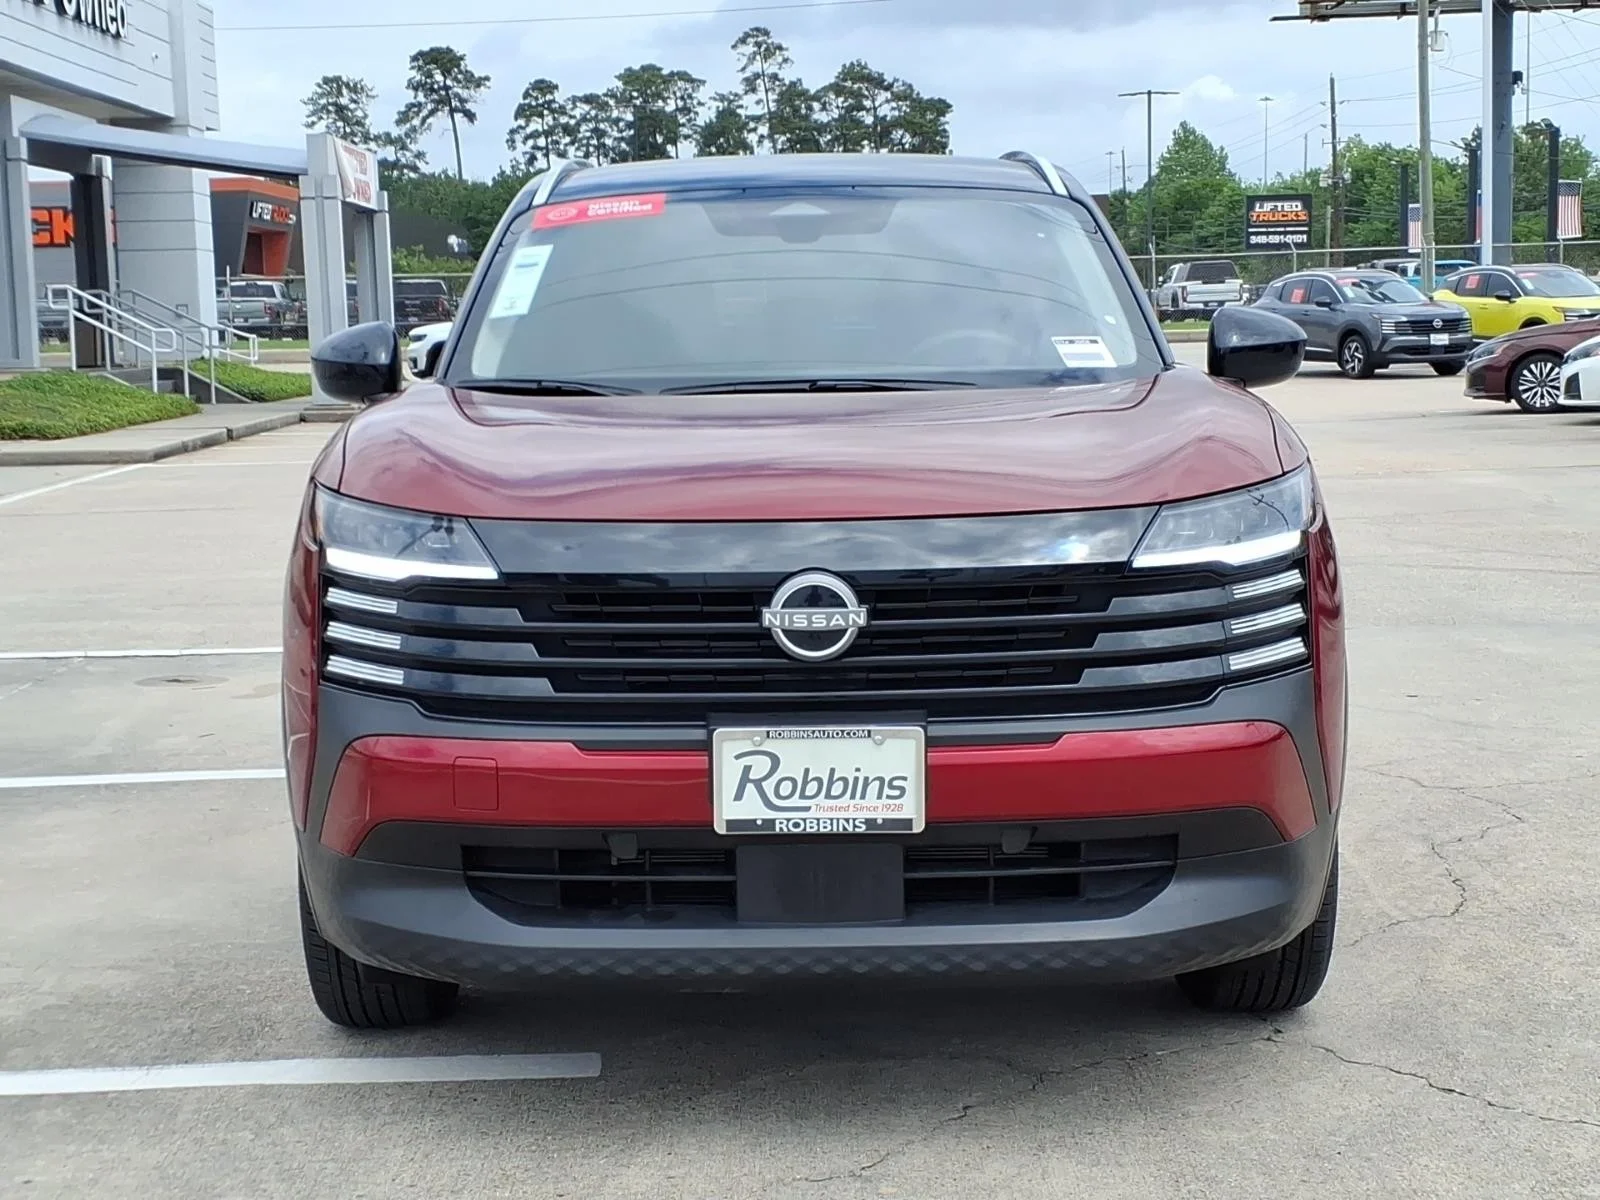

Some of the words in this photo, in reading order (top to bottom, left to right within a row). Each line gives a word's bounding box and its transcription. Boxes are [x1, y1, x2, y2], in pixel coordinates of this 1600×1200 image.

[1255, 201, 1302, 212] LIFTED
[1251, 211, 1308, 222] TRUCKS
[765, 612, 865, 627] NISSAN
[769, 729, 868, 739] ROBBINSAUTO.COM
[733, 749, 908, 813] Robbins
[814, 803, 850, 813] Trusted
[852, 803, 879, 813] Since
[881, 803, 904, 813] 1928
[775, 818, 866, 832] ROBBINS
